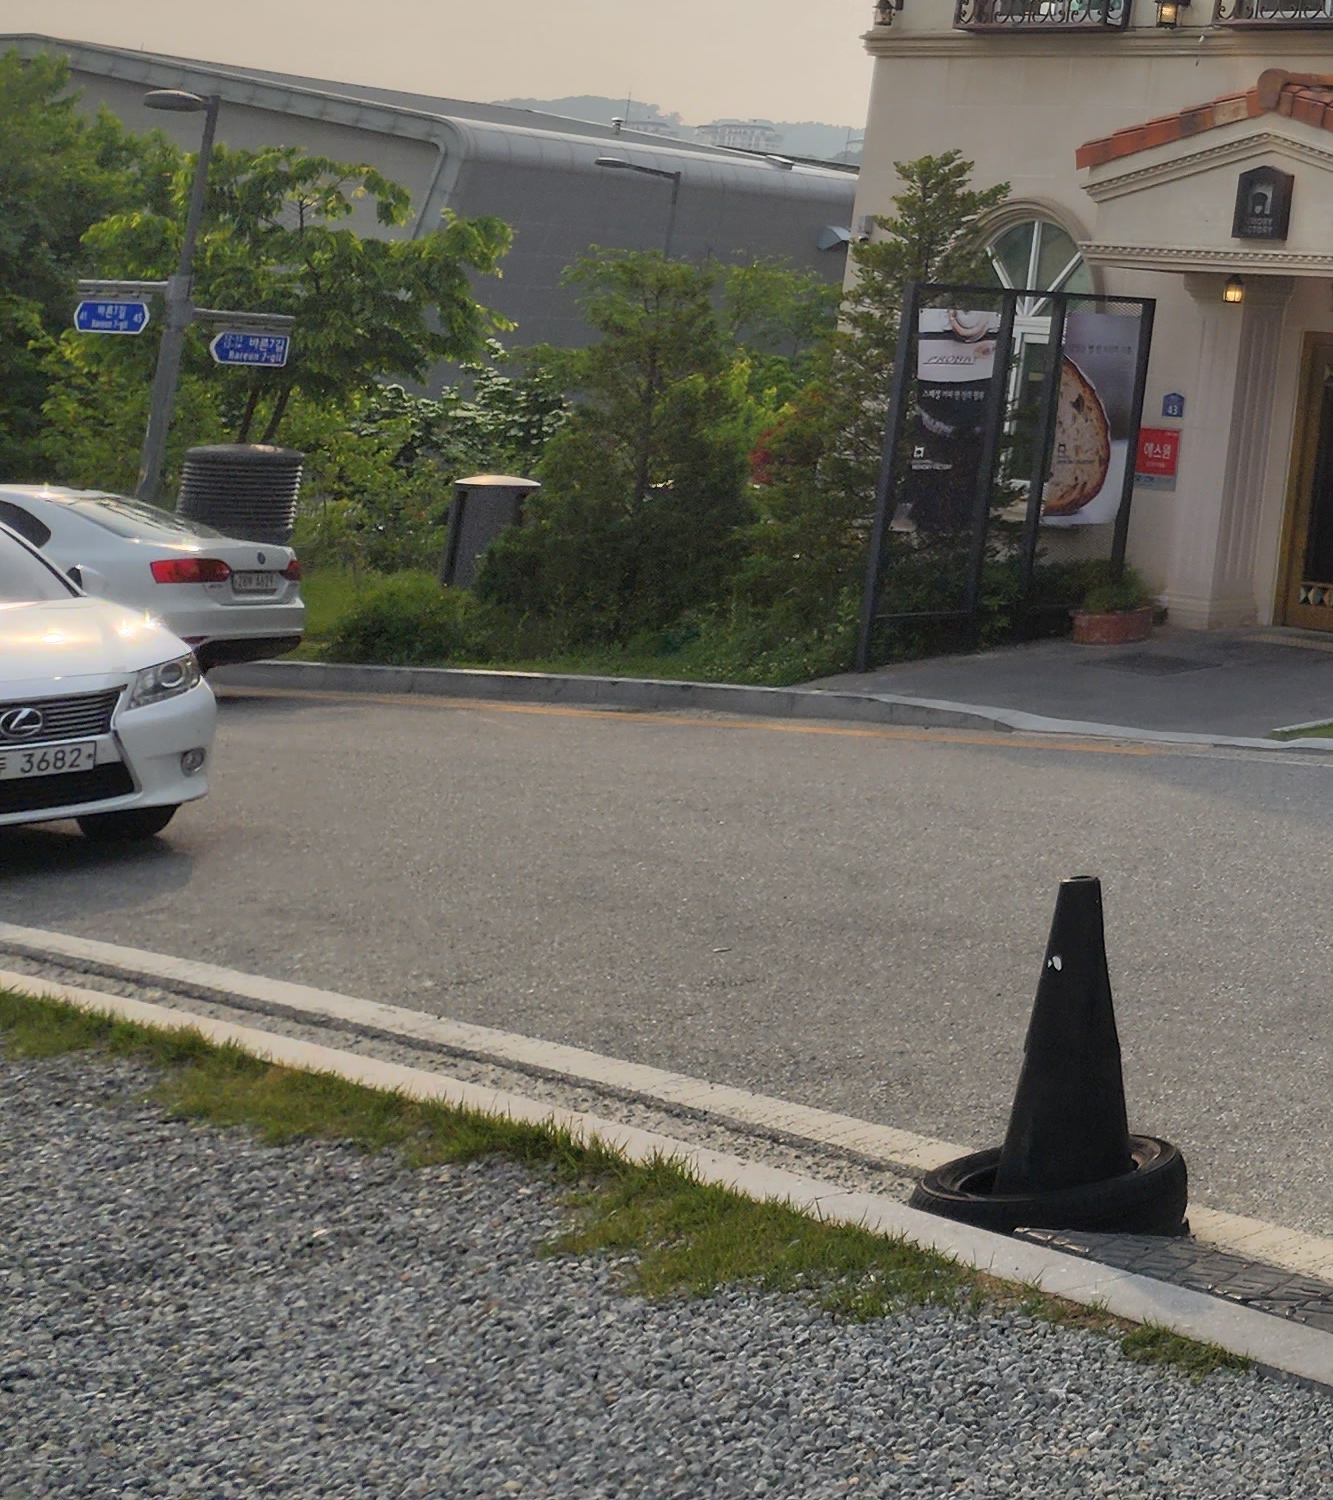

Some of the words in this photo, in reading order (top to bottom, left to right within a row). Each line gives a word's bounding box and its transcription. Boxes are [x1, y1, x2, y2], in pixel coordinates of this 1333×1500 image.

[249, 338, 285, 352] 바른7길
[1168, 405, 1178, 415] 43
[20, 748, 81, 773] 3682
